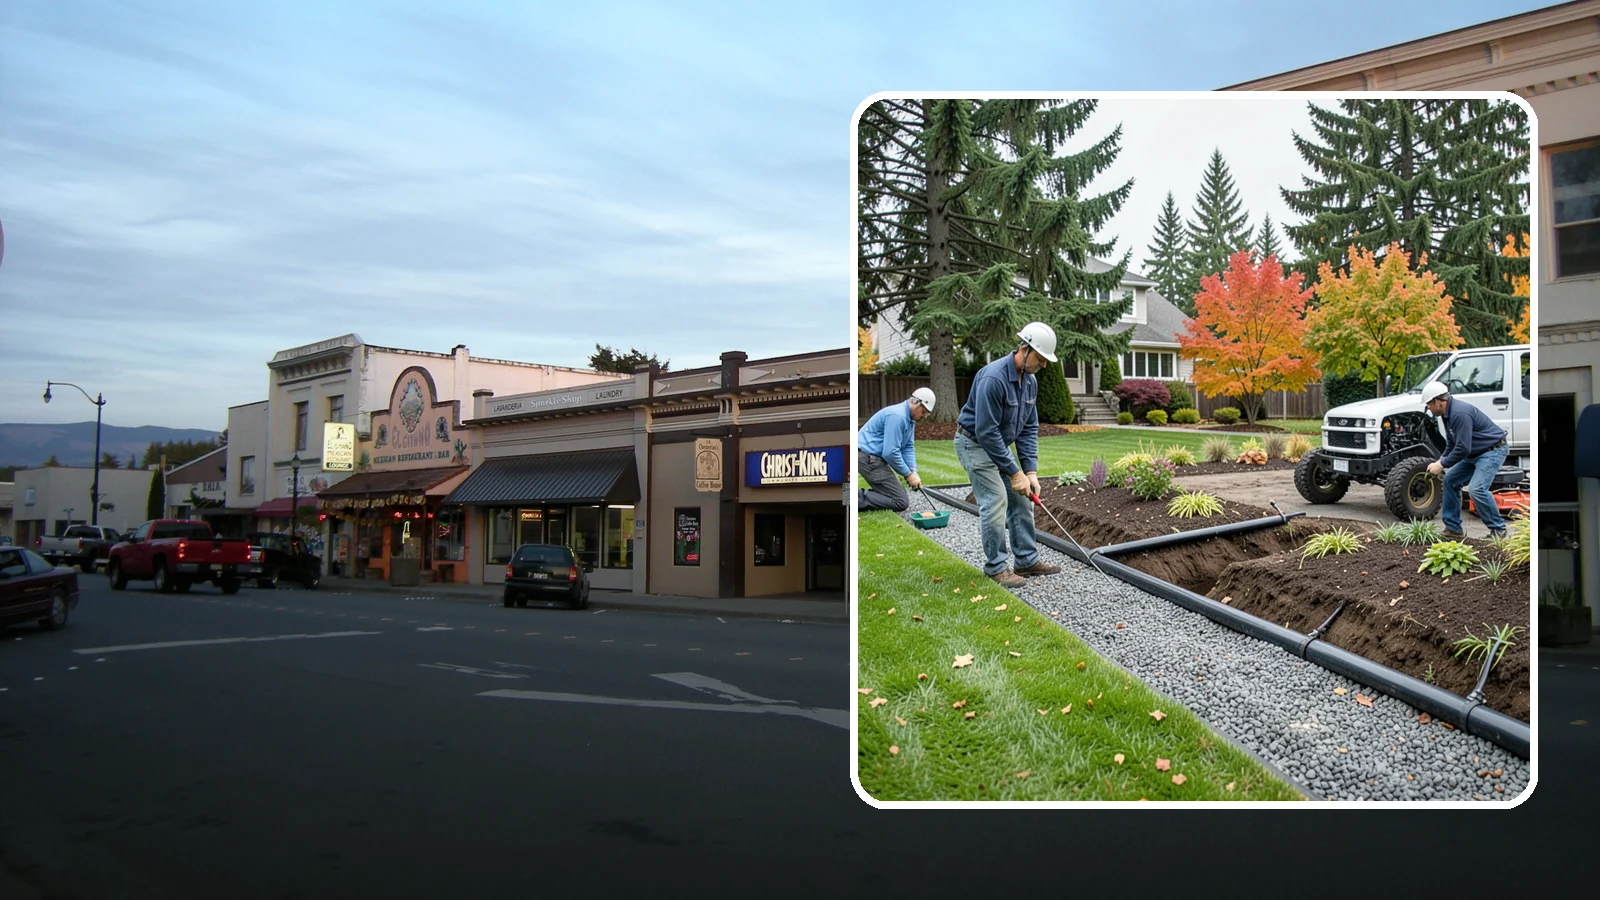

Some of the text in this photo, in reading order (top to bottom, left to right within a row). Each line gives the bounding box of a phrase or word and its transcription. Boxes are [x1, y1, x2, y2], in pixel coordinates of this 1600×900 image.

[561, 394, 582, 404] Shop
[596, 389, 624, 400] LAUNDRY
[494, 402, 522, 412] LAVANDERIA
[373, 455, 396, 464] MEXICAN
[397, 451, 433, 462] RESTAURANT
[438, 450, 450, 459] BAR
[761, 450, 827, 478] CHRIST KING
